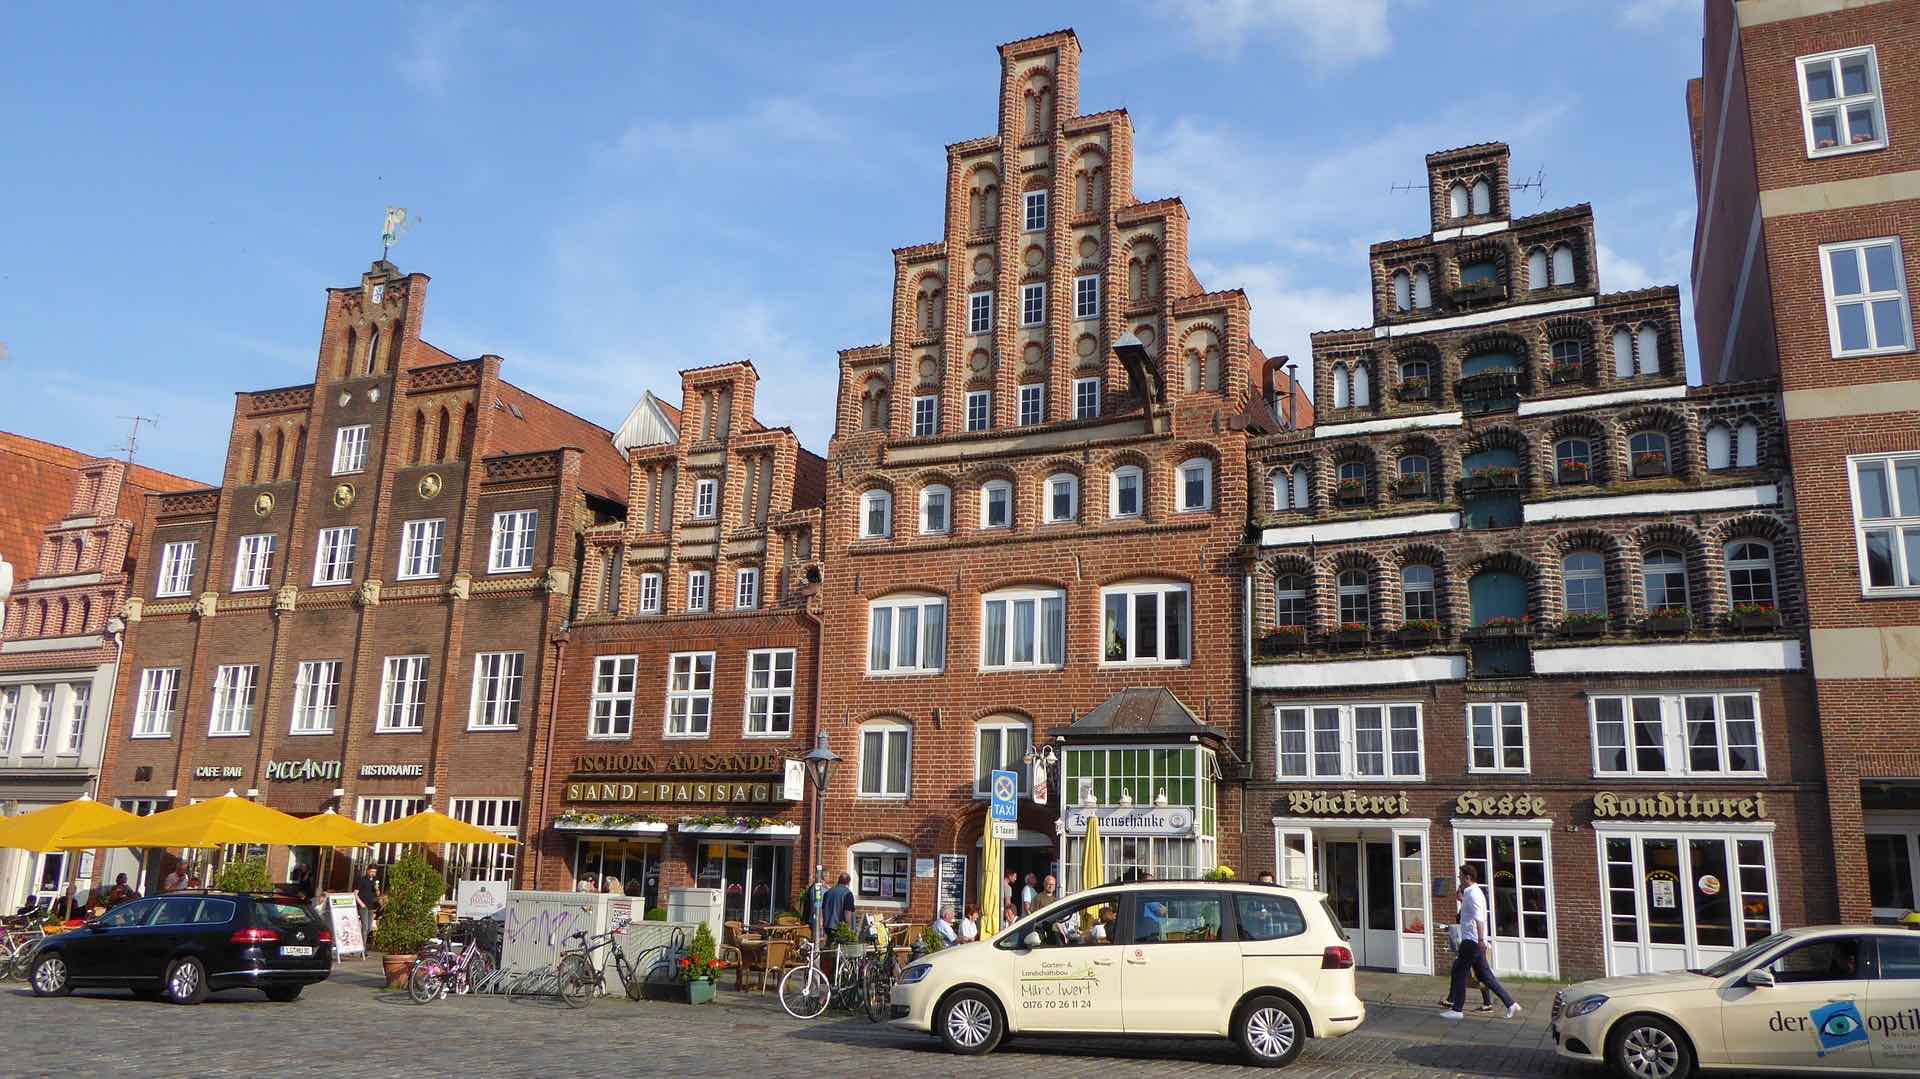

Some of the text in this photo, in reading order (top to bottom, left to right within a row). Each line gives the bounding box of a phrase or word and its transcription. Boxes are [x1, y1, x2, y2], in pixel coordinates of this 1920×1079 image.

[360, 764, 423, 776] RISTORANTE
[669, 752, 700, 770] AM
[705, 752, 775, 772] SANDE
[196, 765, 242, 777] CAFE BAR
[994, 804, 1015, 816] TAXI
[1287, 789, 1409, 815] Bäckerei
[1455, 790, 1547, 816] Hesse
[1592, 791, 1768, 818] Konditorei
[1021, 968, 1069, 977] Landschaftsbau
[1022, 1000, 1092, 1009] 0176 70 26 11 24
[1769, 1010, 1809, 1032] der
